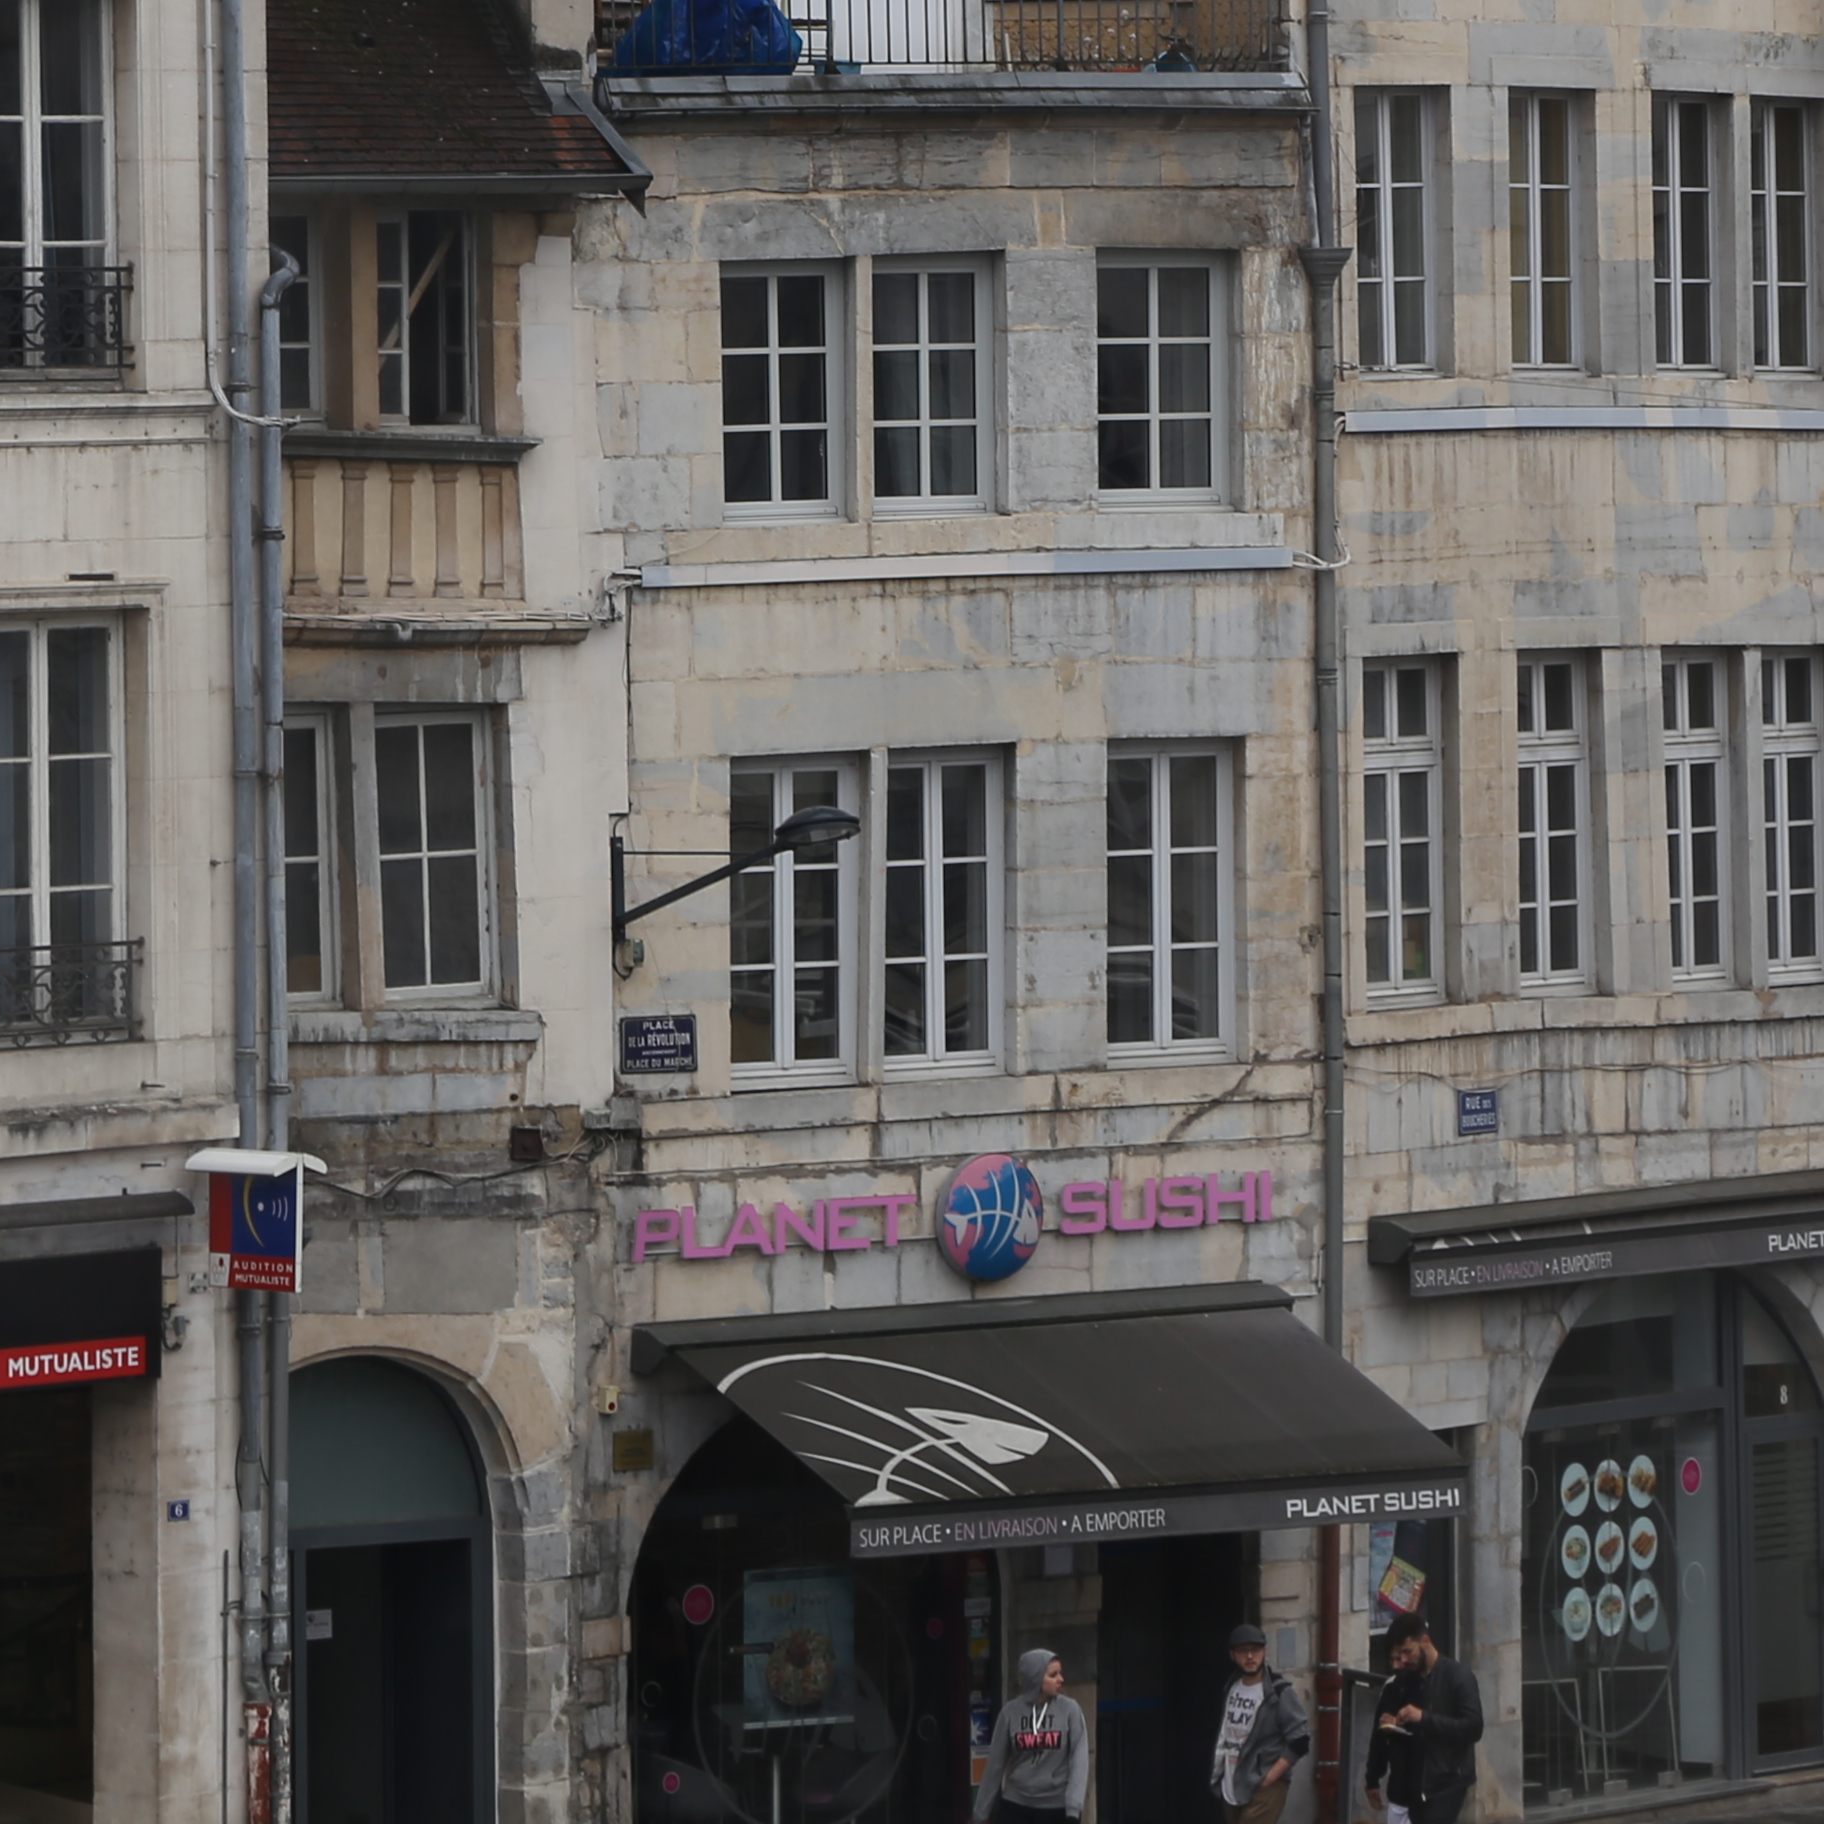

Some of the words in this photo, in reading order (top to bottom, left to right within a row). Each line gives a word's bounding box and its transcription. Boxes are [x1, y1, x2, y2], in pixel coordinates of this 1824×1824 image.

[643, 1020, 675, 1030] PLACE
[628, 1036, 636, 1048] DE
[637, 1036, 645, 1047] LA
[647, 1031, 691, 1047] RÉVOLUTION
[627, 1059, 649, 1069] PLACE
[651, 1058, 661, 1067] DU
[633, 1194, 917, 1263] PLANET
[1060, 1170, 1273, 1235] SUSHI
[233, 1260, 293, 1272] AUDITION
[1415, 1269, 1435, 1287] SUR
[1437, 1267, 1469, 1285] PLACE
[1477, 1265, 1490, 1283] EN
[1493, 1260, 1544, 1281] LIVRAISON
[1552, 1258, 1560, 1274] A
[1561, 1251, 1613, 1274] EMPORTER
[235, 1274, 290, 1286] MUTUALISTE
[7, 1346, 139, 1379] MUTUALISTE
[1780, 1384, 1788, 1404] 8
[175, 1503, 183, 1517] 6
[1286, 1494, 1380, 1519] PLANET
[1384, 1488, 1460, 1512] SUSHI
[859, 1527, 890, 1547] SUR
[893, 1524, 942, 1545] PLACE
[954, 1522, 975, 1541] EN
[979, 1517, 1058, 1540] LIVRAISON
[1071, 1515, 1083, 1532] A
[1086, 1508, 1166, 1532] EMPORTER
[1016, 1731, 1060, 1749] SWEAT
